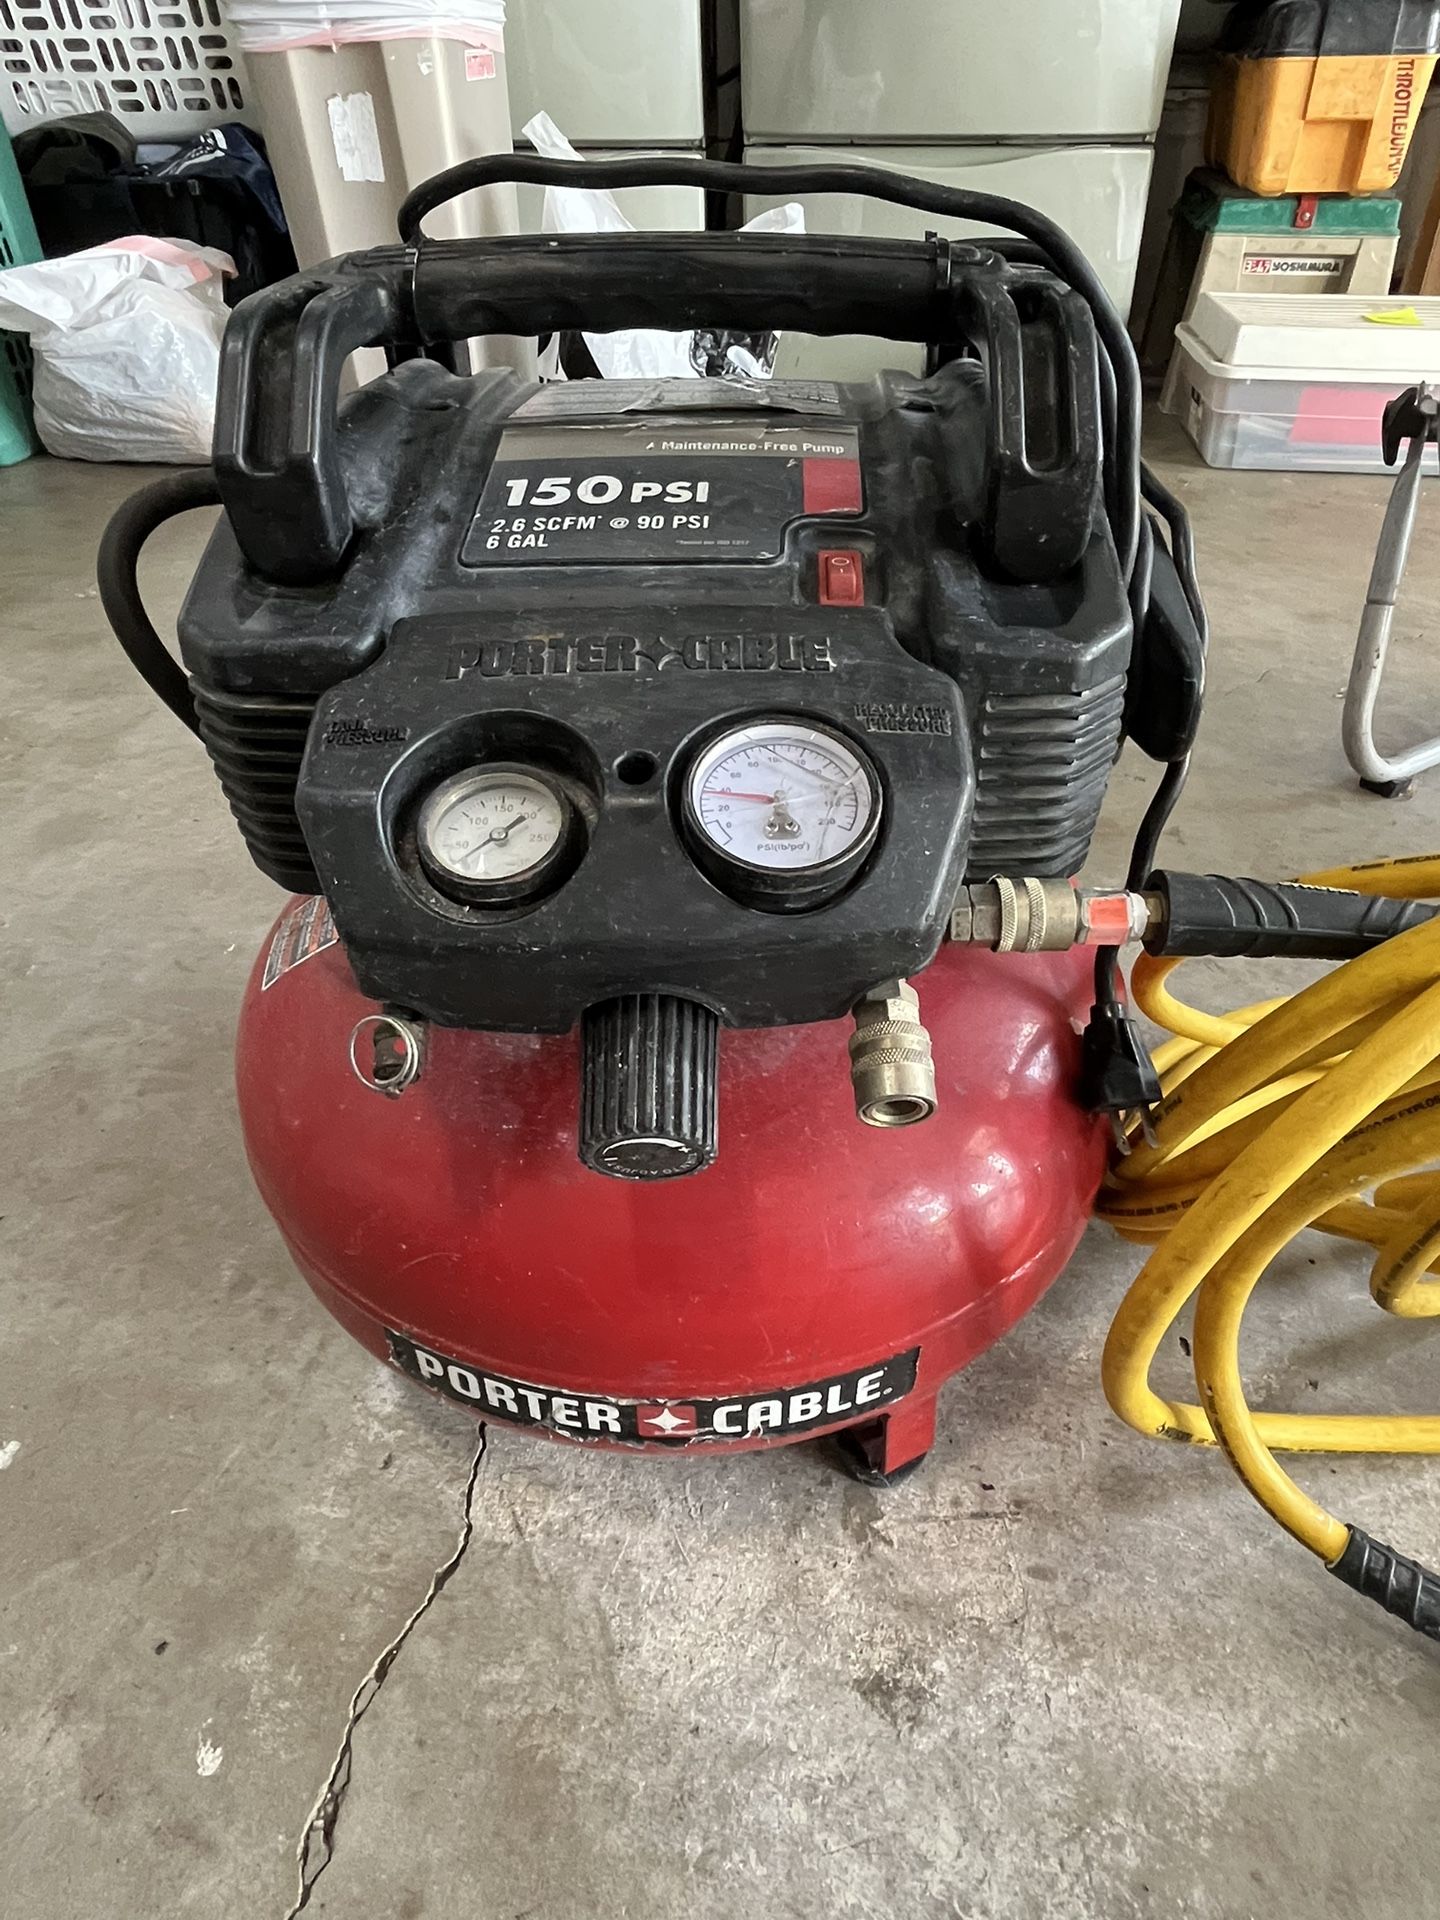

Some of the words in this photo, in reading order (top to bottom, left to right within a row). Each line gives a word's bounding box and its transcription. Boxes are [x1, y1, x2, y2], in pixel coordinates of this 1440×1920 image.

[1271, 261, 1340, 273] YOSHIMURA
[662, 441, 798, 452] Maintenance-Free
[802, 443, 845, 455] Pump
[505, 475, 624, 507] 150
[630, 481, 710, 504] PSI
[490, 519, 527, 533] 2.6
[609, 517, 630, 529] @
[637, 515, 665, 529] 90
[672, 515, 710, 529] PSI
[486, 536, 500, 549] 6
[507, 533, 549, 548] GAL
[444, 634, 640, 681] PORTER
[682, 633, 836, 673] CABLE
[494, 803, 514, 813] 150
[717, 804, 731, 813] 20
[469, 816, 490, 826] 100
[415, 1349, 622, 1434] PORTER
